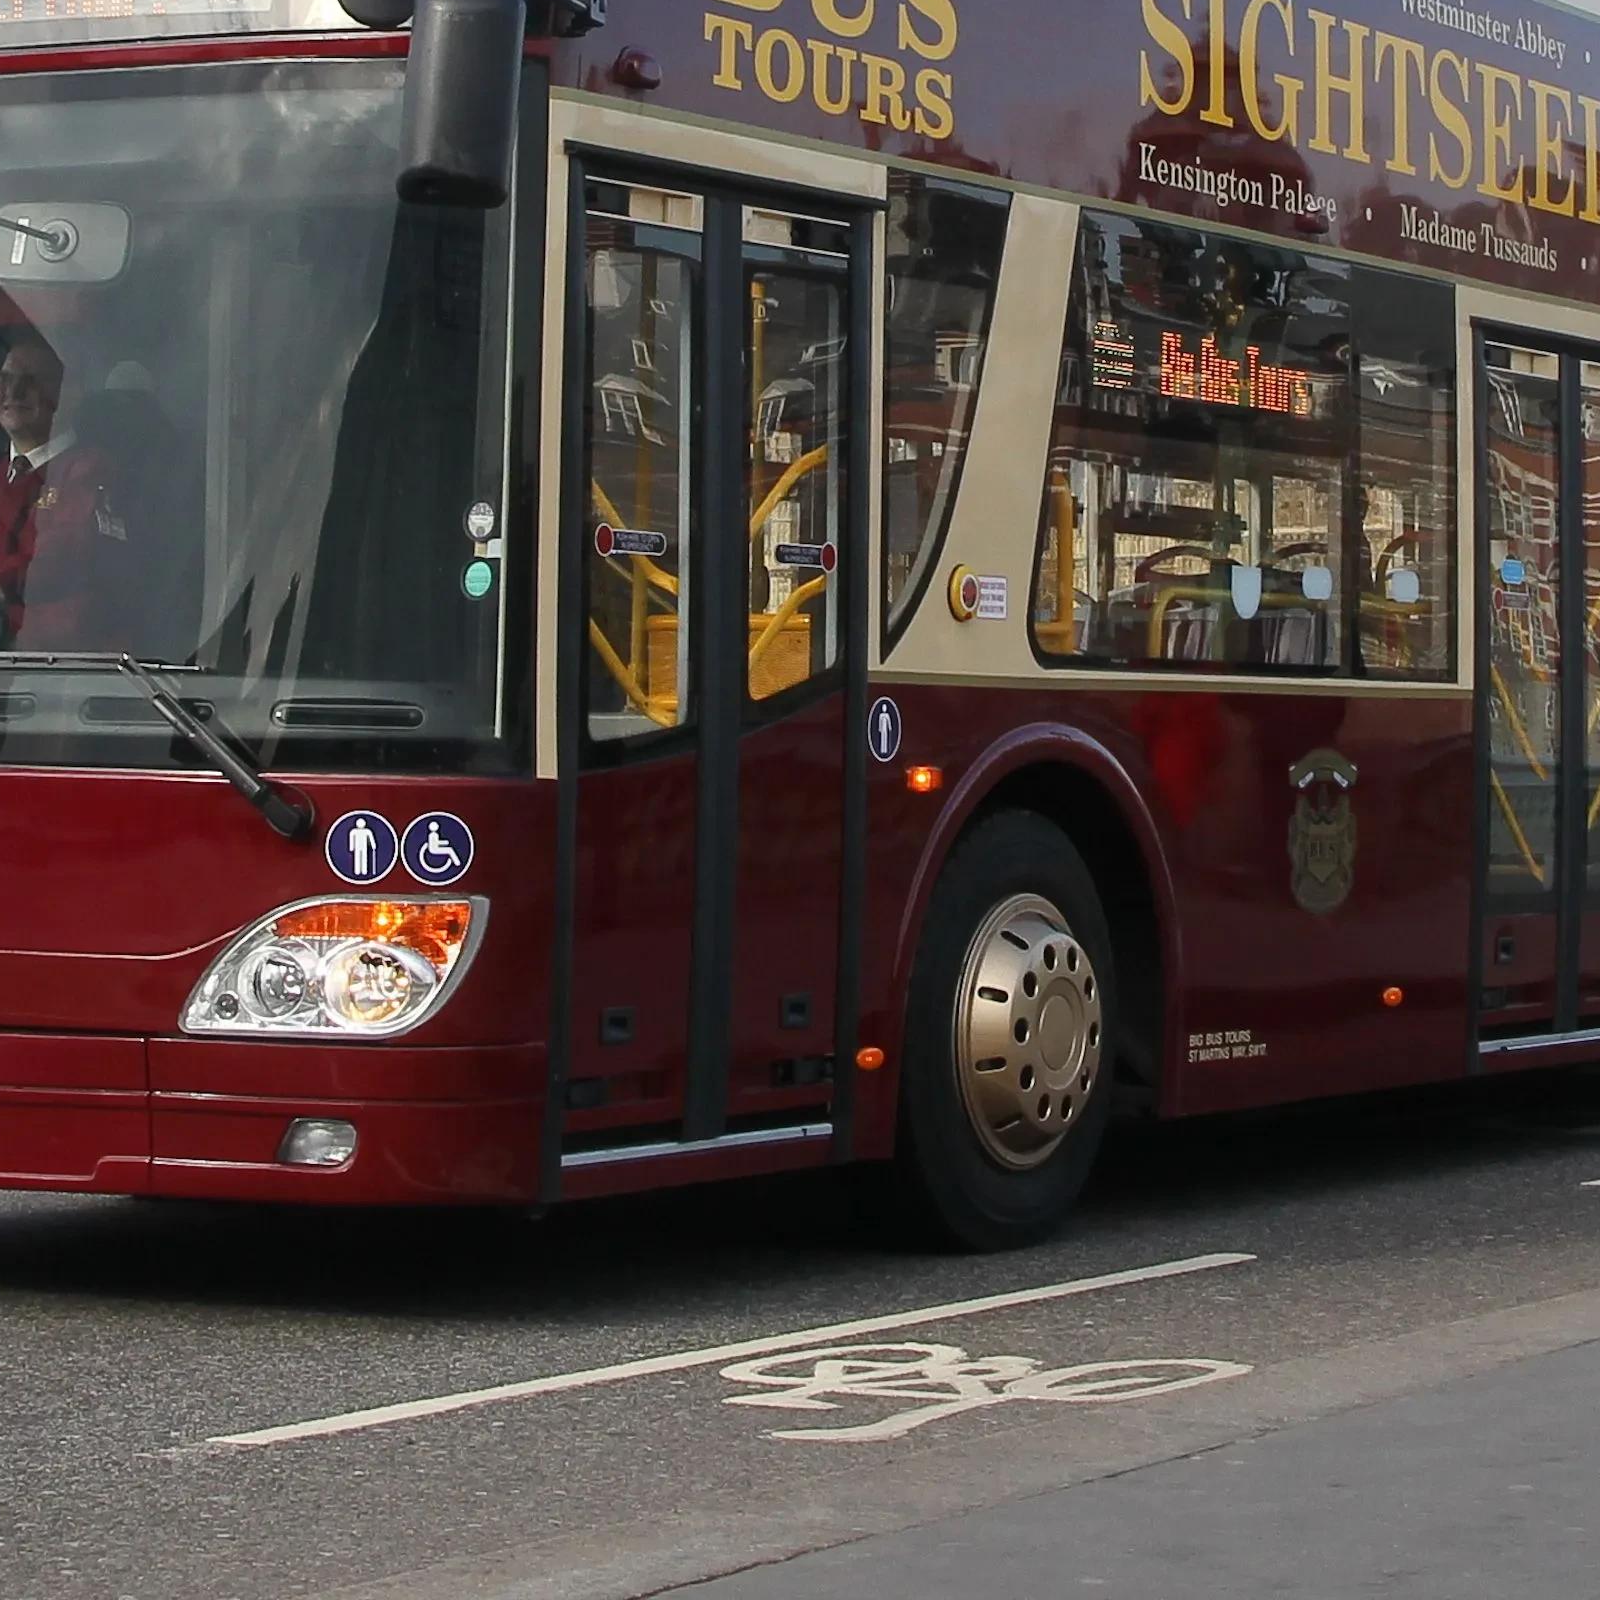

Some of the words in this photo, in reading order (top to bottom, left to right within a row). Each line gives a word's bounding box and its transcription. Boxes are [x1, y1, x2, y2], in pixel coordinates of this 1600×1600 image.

[704, 13, 955, 140] TOURS
[1514, 20, 1567, 69] Abbey
[1138, 142, 1264, 208] Kensington
[1269, 173, 1337, 222] Palace
[1400, 203, 1477, 255] Madame
[1481, 227, 1558, 272] Tussauds
[1189, 1034, 1204, 1047] BIG
[1205, 1032, 1224, 1046] BUS
[1224, 1029, 1252, 1044] TOURS
